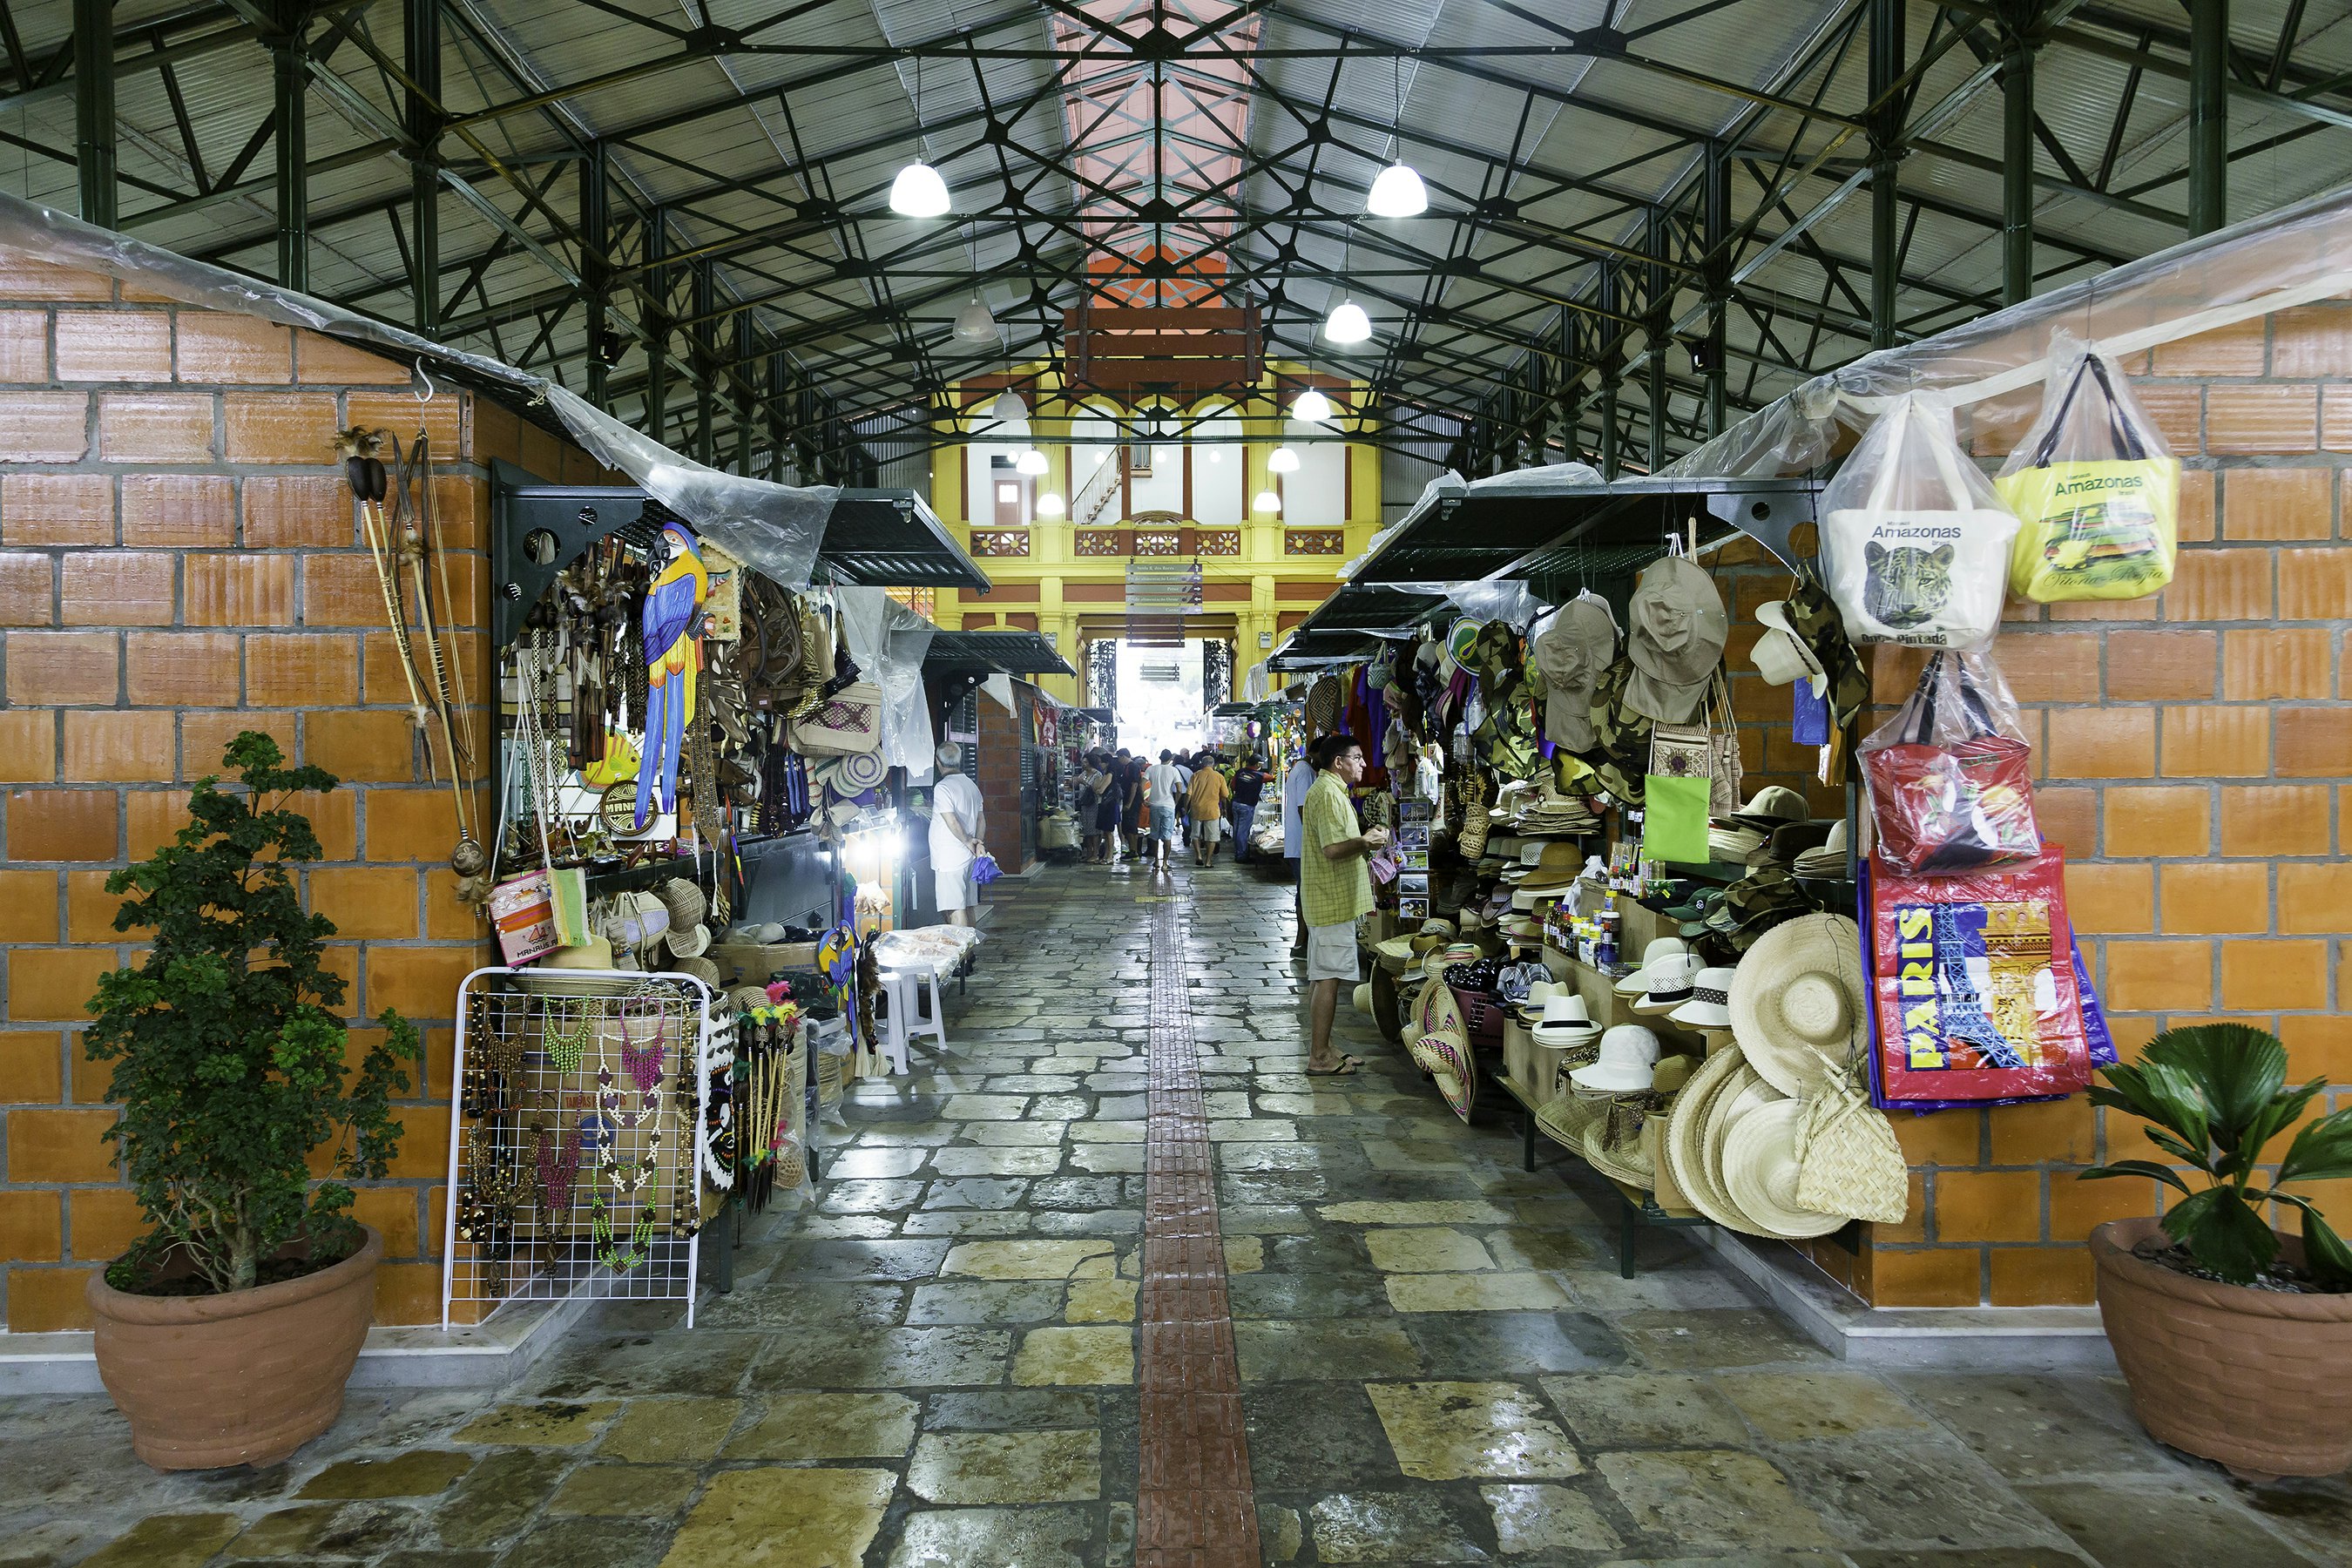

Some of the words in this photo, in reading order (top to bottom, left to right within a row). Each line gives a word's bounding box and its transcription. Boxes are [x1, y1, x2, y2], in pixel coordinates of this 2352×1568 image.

[2055, 476, 2144, 497] Amazonas
[1871, 525, 1962, 538] Amazonas
[1896, 632, 1948, 645] Pintada
[1899, 907, 1943, 1068] PARIS
